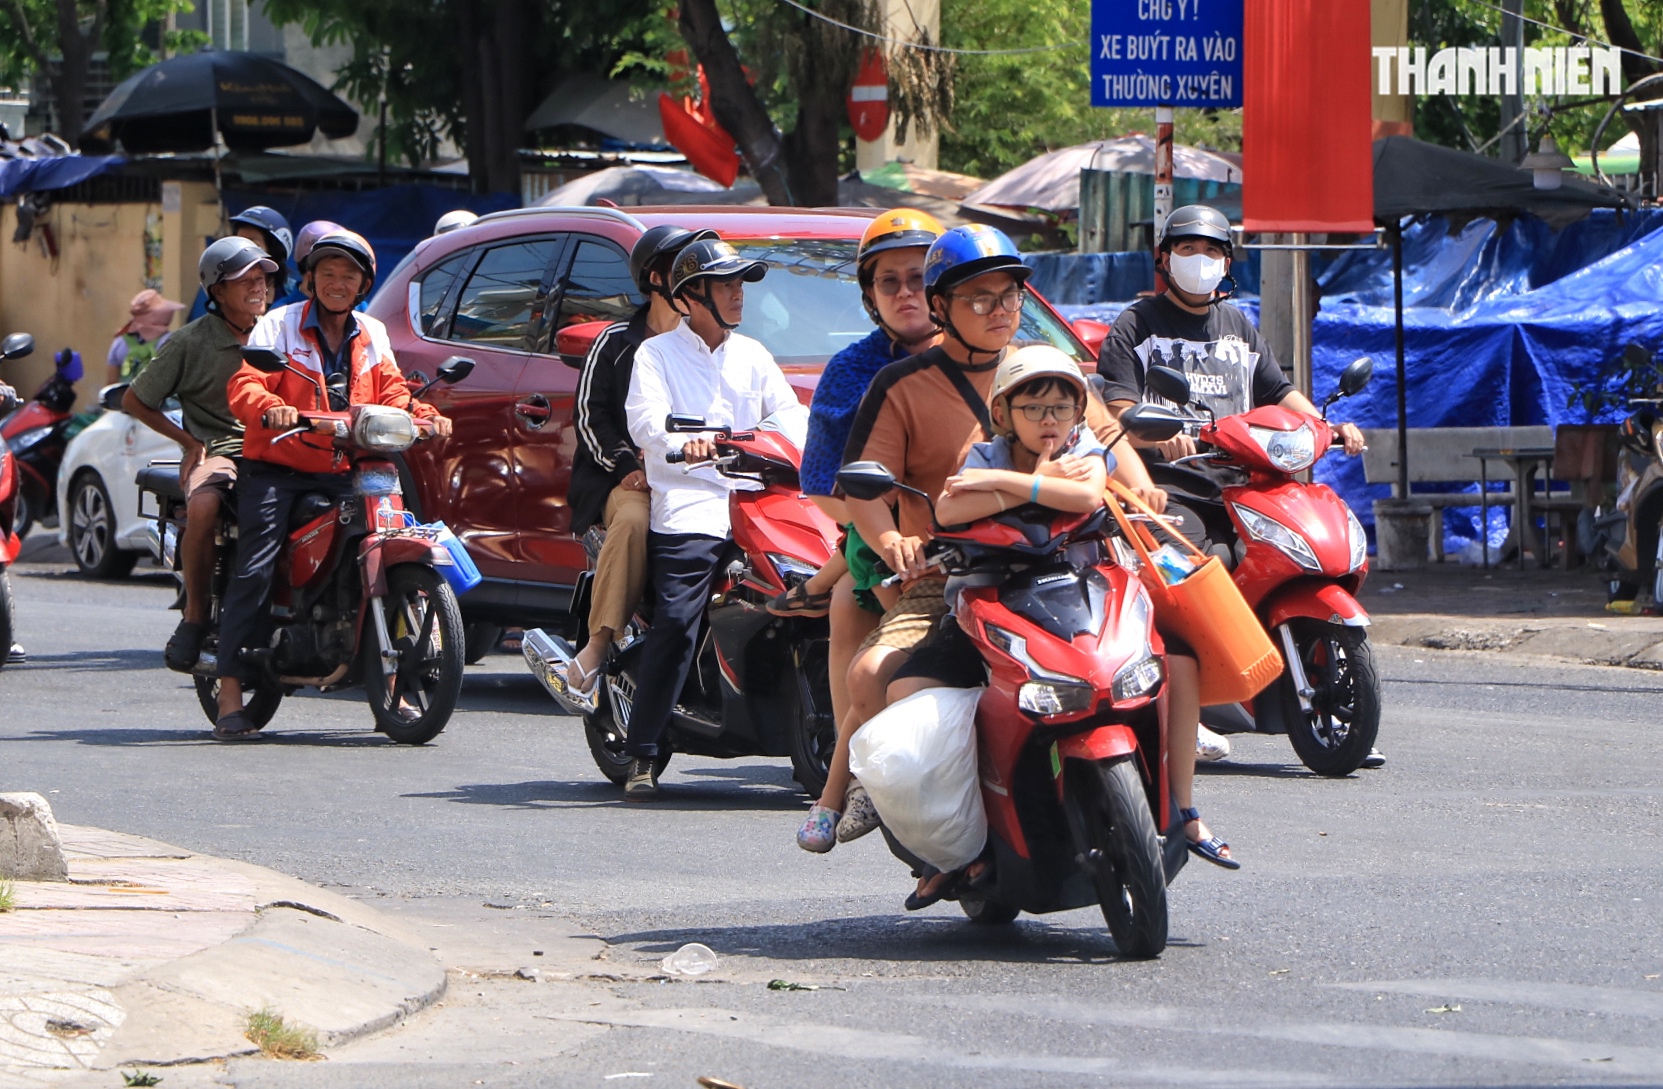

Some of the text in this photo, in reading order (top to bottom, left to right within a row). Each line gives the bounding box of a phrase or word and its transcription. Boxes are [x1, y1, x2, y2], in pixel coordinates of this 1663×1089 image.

[1100, 29, 1236, 62] XE BUÝT RA VÀO
[1102, 68, 1233, 100] THƯỜNG XUYÊN
